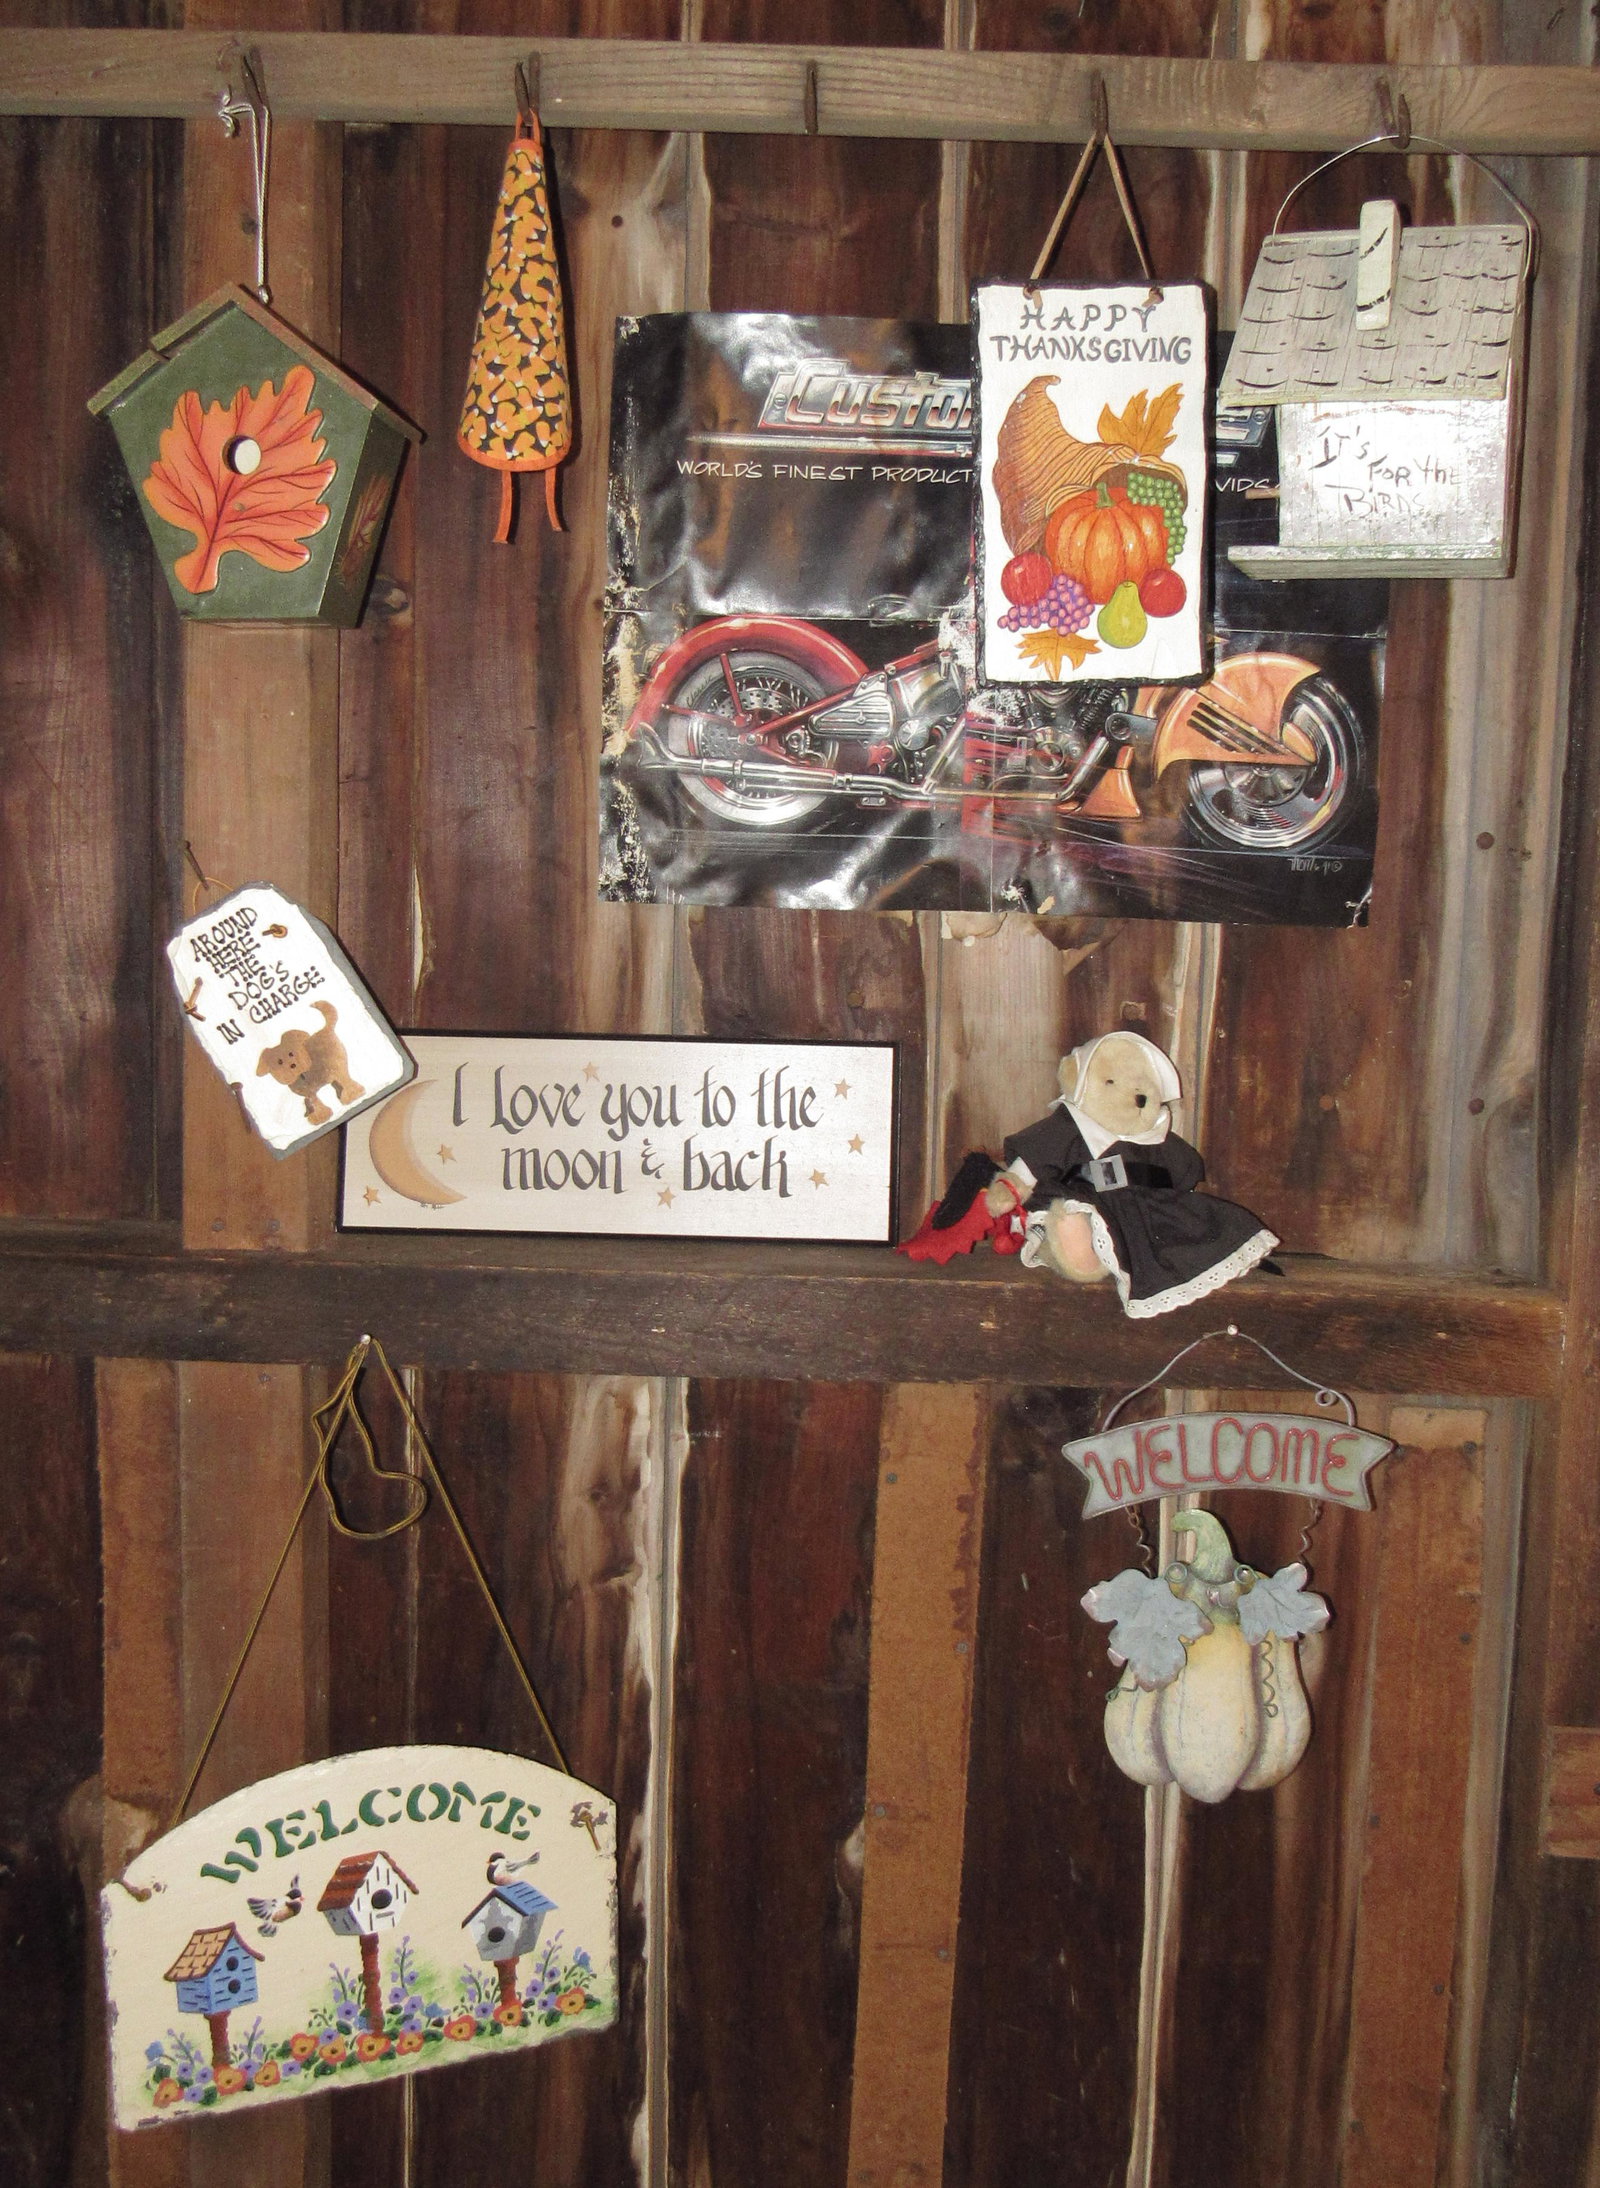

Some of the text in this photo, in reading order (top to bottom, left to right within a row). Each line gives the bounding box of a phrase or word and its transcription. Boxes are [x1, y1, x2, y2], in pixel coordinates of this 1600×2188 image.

[1019, 303, 1156, 332] HAPPY
[989, 335, 1192, 365] THANKSGIVING
[676, 459, 763, 479] WORLD'S
[772, 463, 863, 481] FINEST
[871, 465, 974, 484] PRODUCT
[189, 907, 258, 962] AROUND
[205, 931, 262, 973] HERE
[219, 954, 266, 987] THE
[228, 960, 290, 1010] DOG'S
[216, 965, 325, 1044] IN CHARGE
[452, 1062, 470, 1128] I
[600, 1081, 683, 1141] you
[694, 1065, 736, 1128] to
[751, 1065, 824, 1131] the
[502, 1144, 628, 1194] moon
[683, 1134, 794, 1198] back
[1083, 1417, 1360, 1501] WELCOME
[200, 1781, 541, 1884] WELCOME
